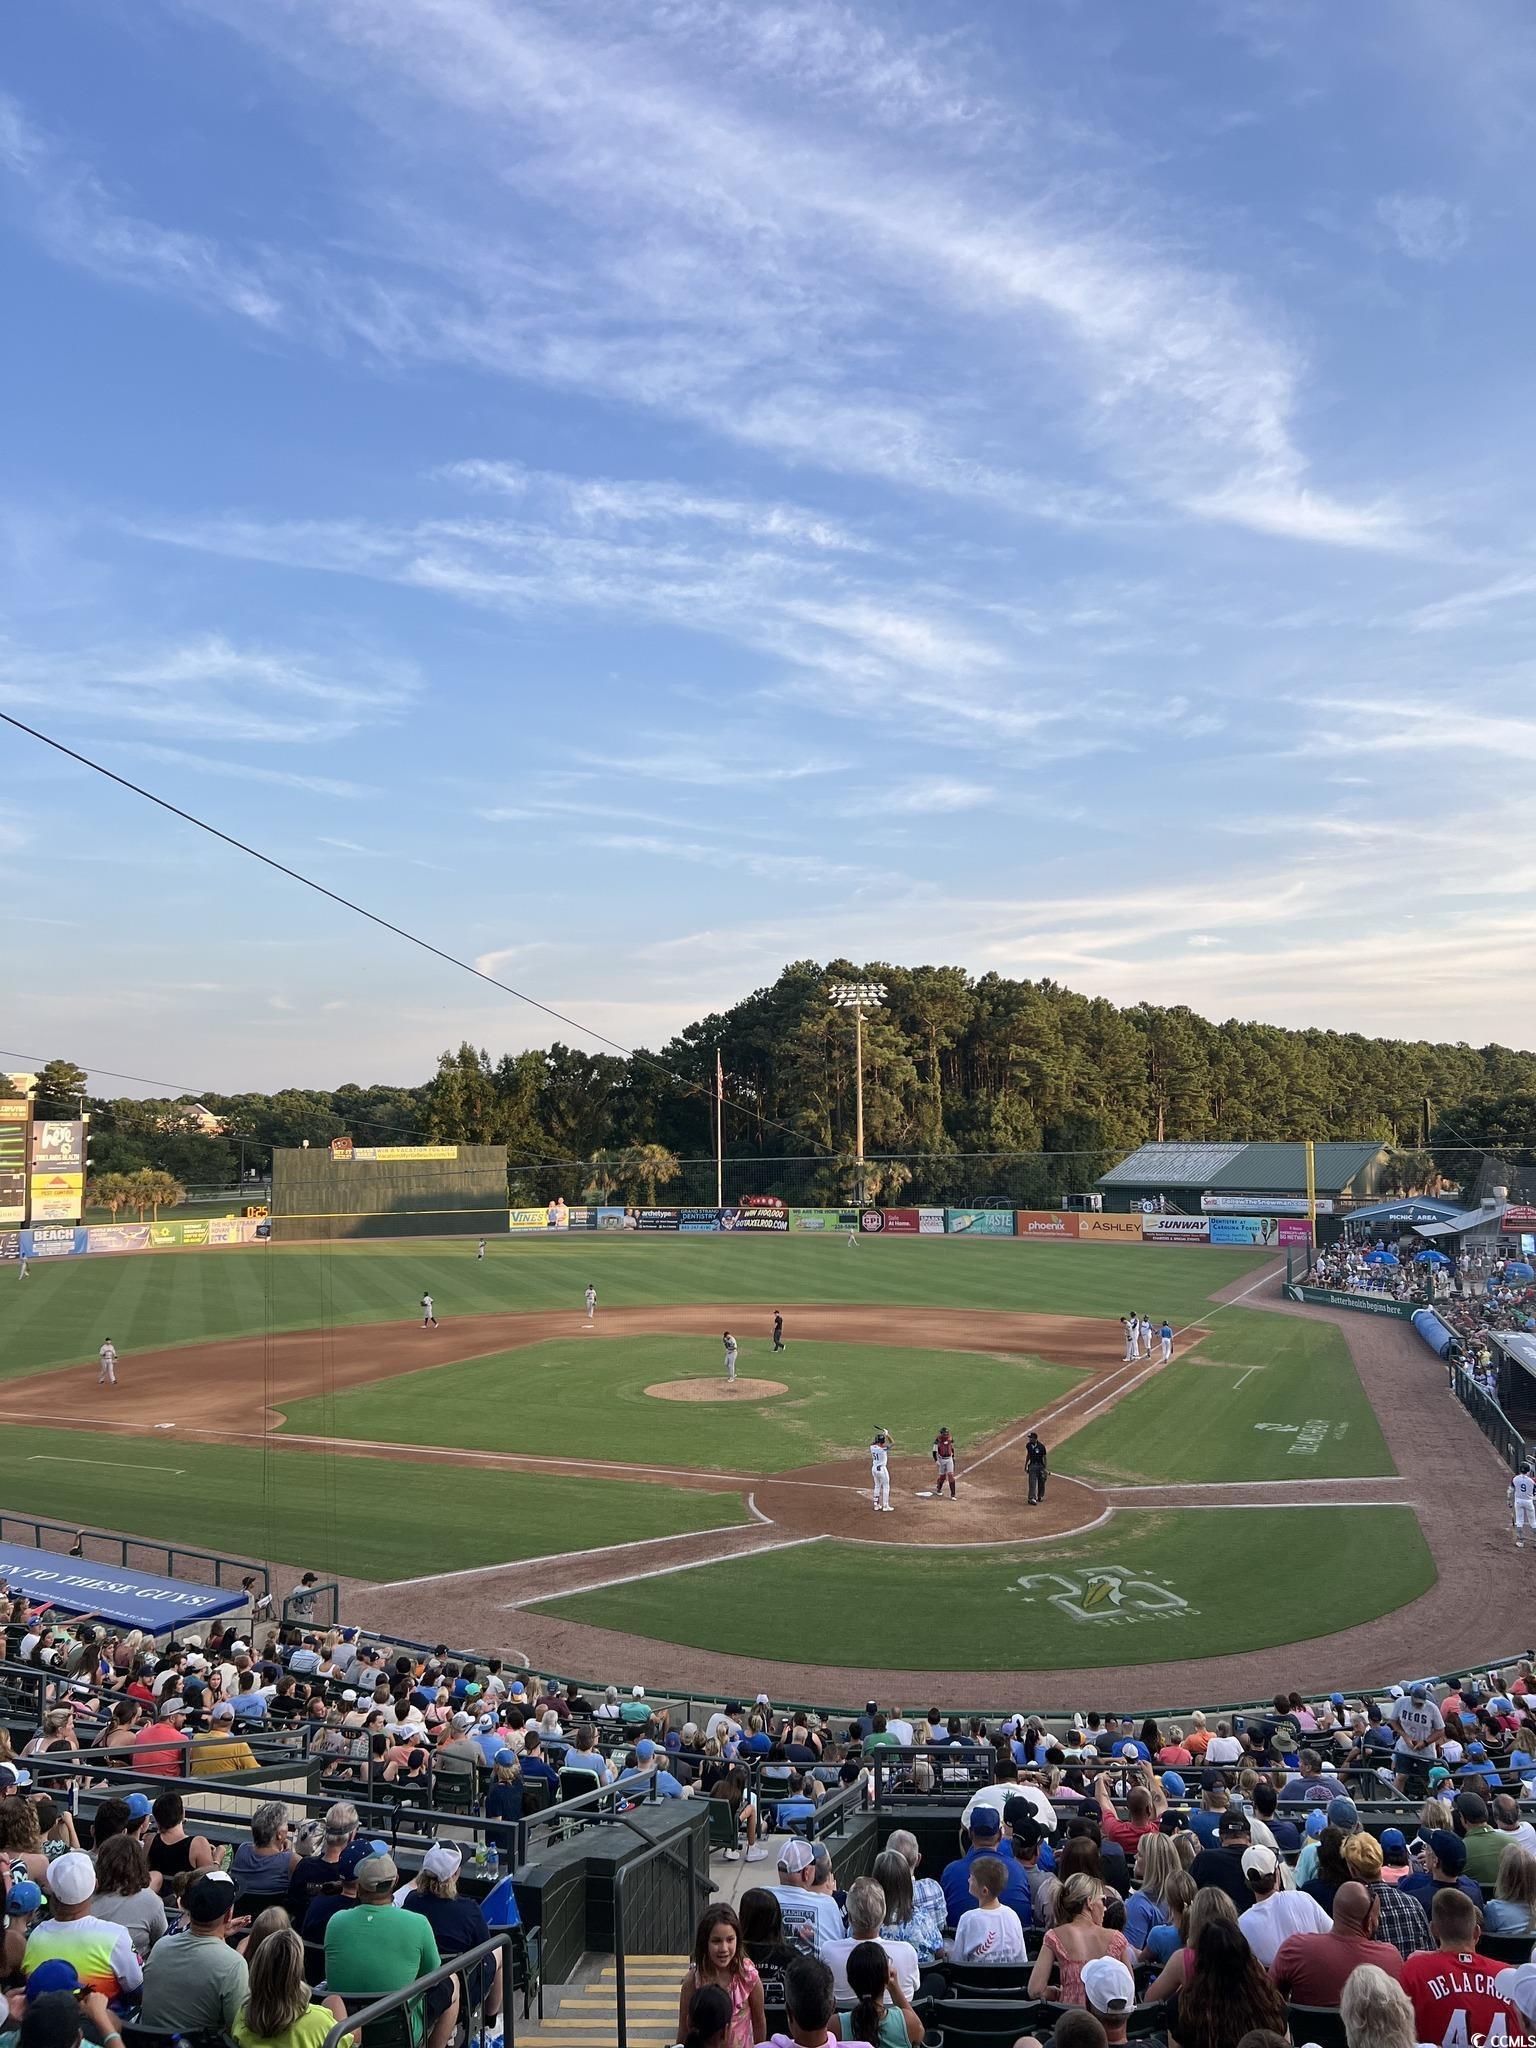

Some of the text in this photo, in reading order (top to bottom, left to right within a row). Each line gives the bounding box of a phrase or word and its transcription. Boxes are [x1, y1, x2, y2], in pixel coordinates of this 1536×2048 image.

[247, 1206, 268, 1218] 0:25
[682, 1213, 717, 1221] DENTISTRY
[744, 1209, 784, 1219] WIN $100,000
[735, 1217, 788, 1231] GOTAXELROD.COM
[985, 1213, 1012, 1227] TASTE
[1028, 1220, 1065, 1232] phoenix
[1158, 1220, 1208, 1231] SUNWAY
[1092, 1221, 1142, 1232] ASHLEY
[34, 1229, 74, 1242] BEACH
[1330, 1295, 1346, 1306] Better
[1386, 1304, 1403, 1314] here.
[1520, 1483, 1527, 1493] 9
[22, 1569, 60, 1581] TO
[56, 1575, 138, 1594] THESE
[136, 1588, 218, 1607] GUYS!
[1094, 1606, 1202, 1627] SEASONS
[345, 1731, 357, 1739] 113
[1427, 1975, 1450, 2000] DE
[1449, 1972, 1473, 1994] LA
